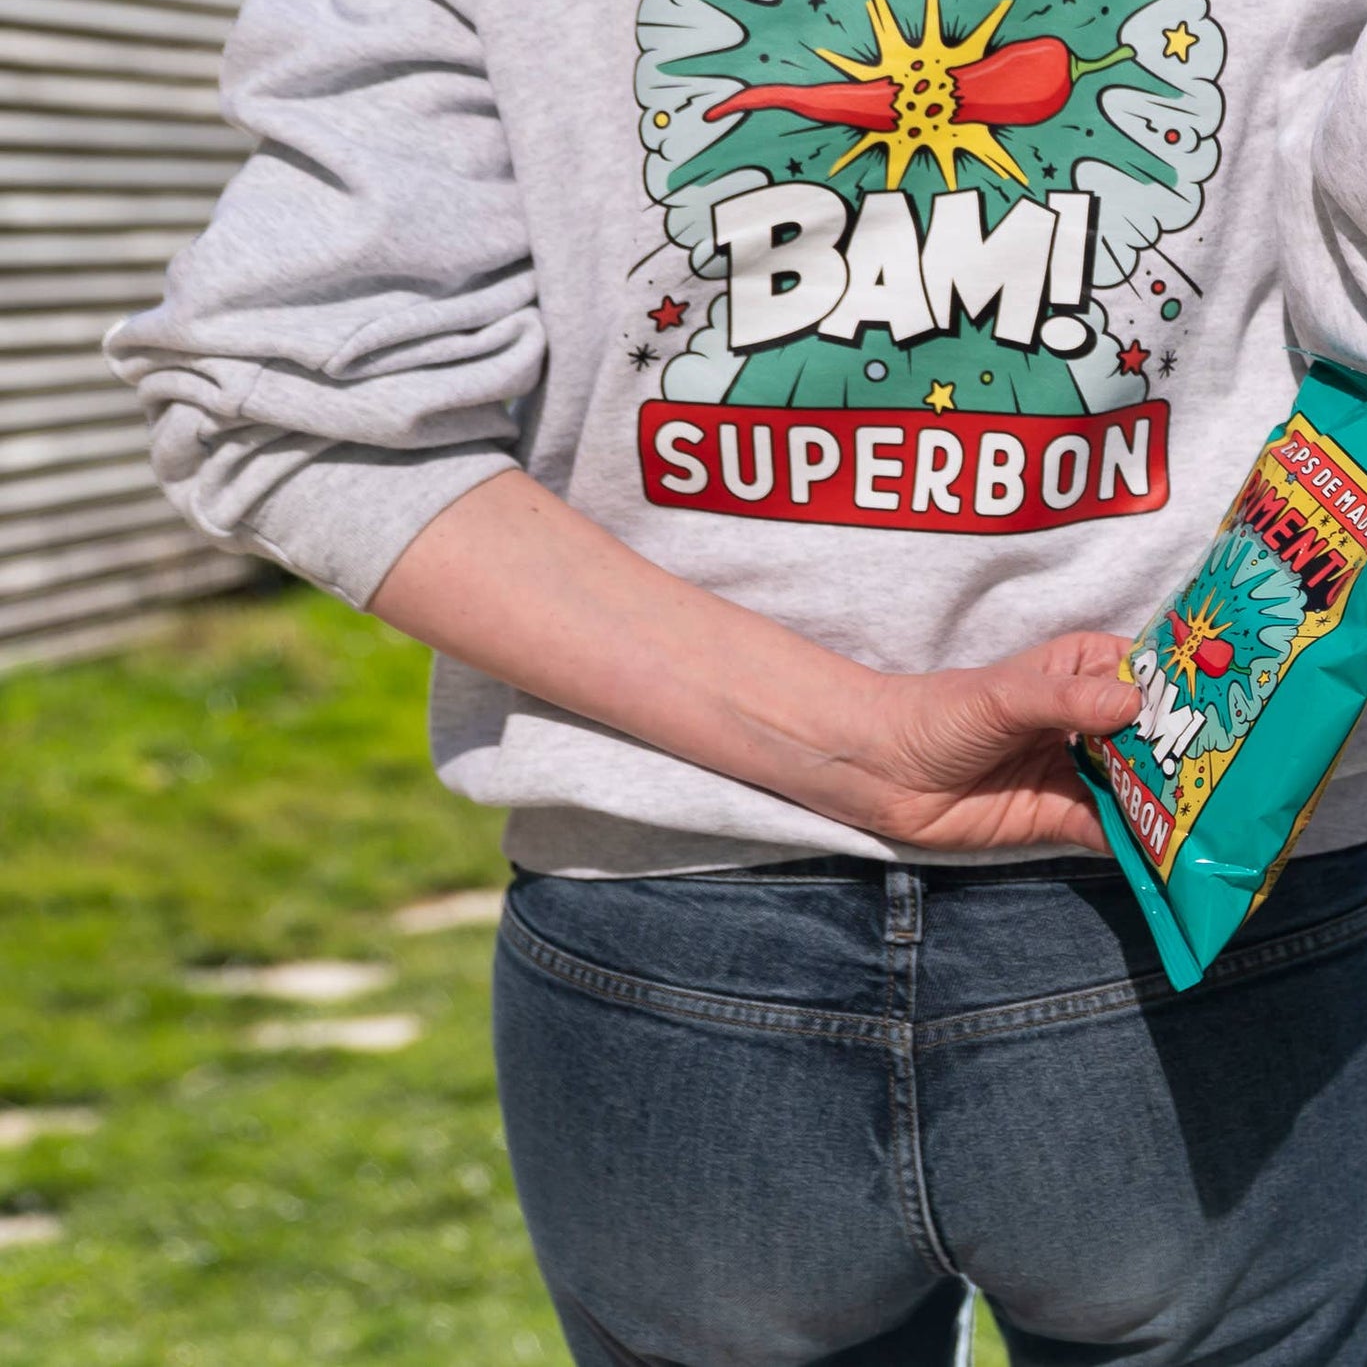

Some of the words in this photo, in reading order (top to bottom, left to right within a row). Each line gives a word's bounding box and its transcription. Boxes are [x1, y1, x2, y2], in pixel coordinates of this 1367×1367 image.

[711, 181, 1099, 360] BAM!
[653, 417, 1152, 517] SUPERBON
[1311, 467, 1343, 499] DE
